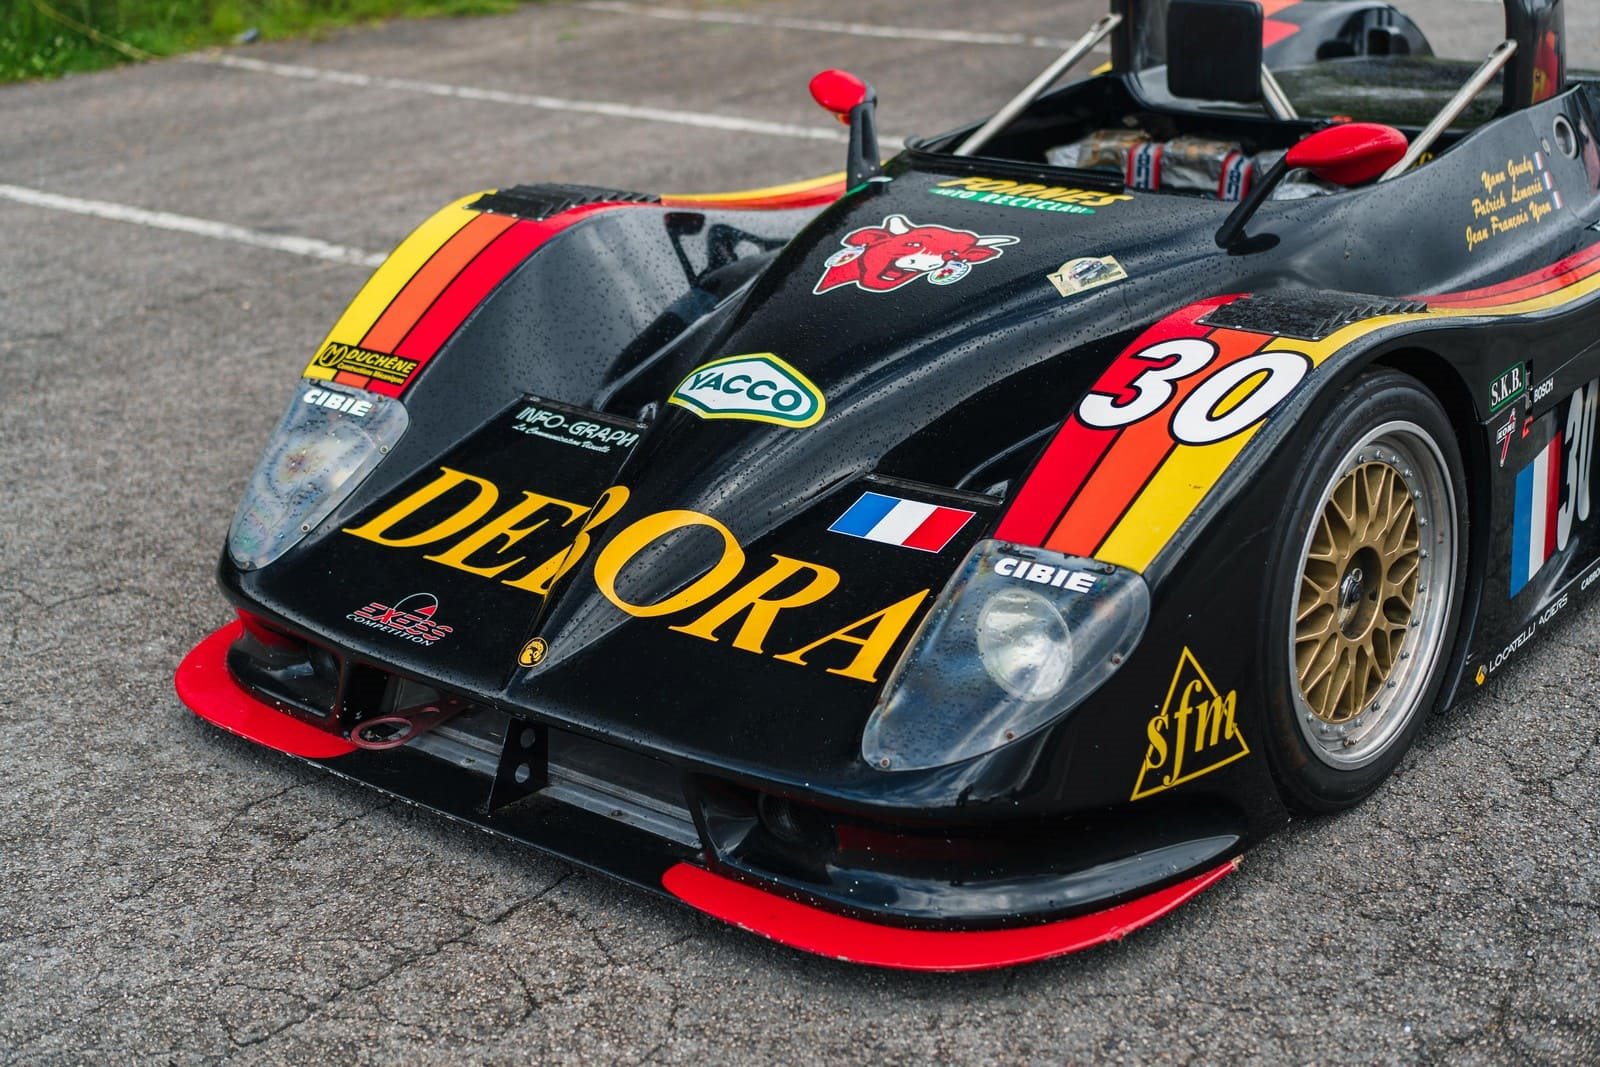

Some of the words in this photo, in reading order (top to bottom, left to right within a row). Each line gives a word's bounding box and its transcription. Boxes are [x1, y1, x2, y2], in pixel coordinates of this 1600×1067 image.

[1472, 191, 1506, 218] Patrick
[1466, 226, 1488, 251] Jean
[303, 389, 373, 417] CIBIE
[689, 372, 802, 412] YACCO
[1076, 337, 1312, 445] 30
[1491, 367, 1522, 407] S.K.B.
[1534, 377, 1553, 403] BOSCH
[516, 407, 639, 447] INFO-GRAPH
[1557, 377, 1600, 551] 30
[342, 466, 931, 683] DEBORA
[994, 557, 1097, 594] CIBIE
[345, 613, 434, 647] COMPETITION
[1489, 622, 1536, 672] LOCATELLI
[1147, 679, 1237, 786] sfm
